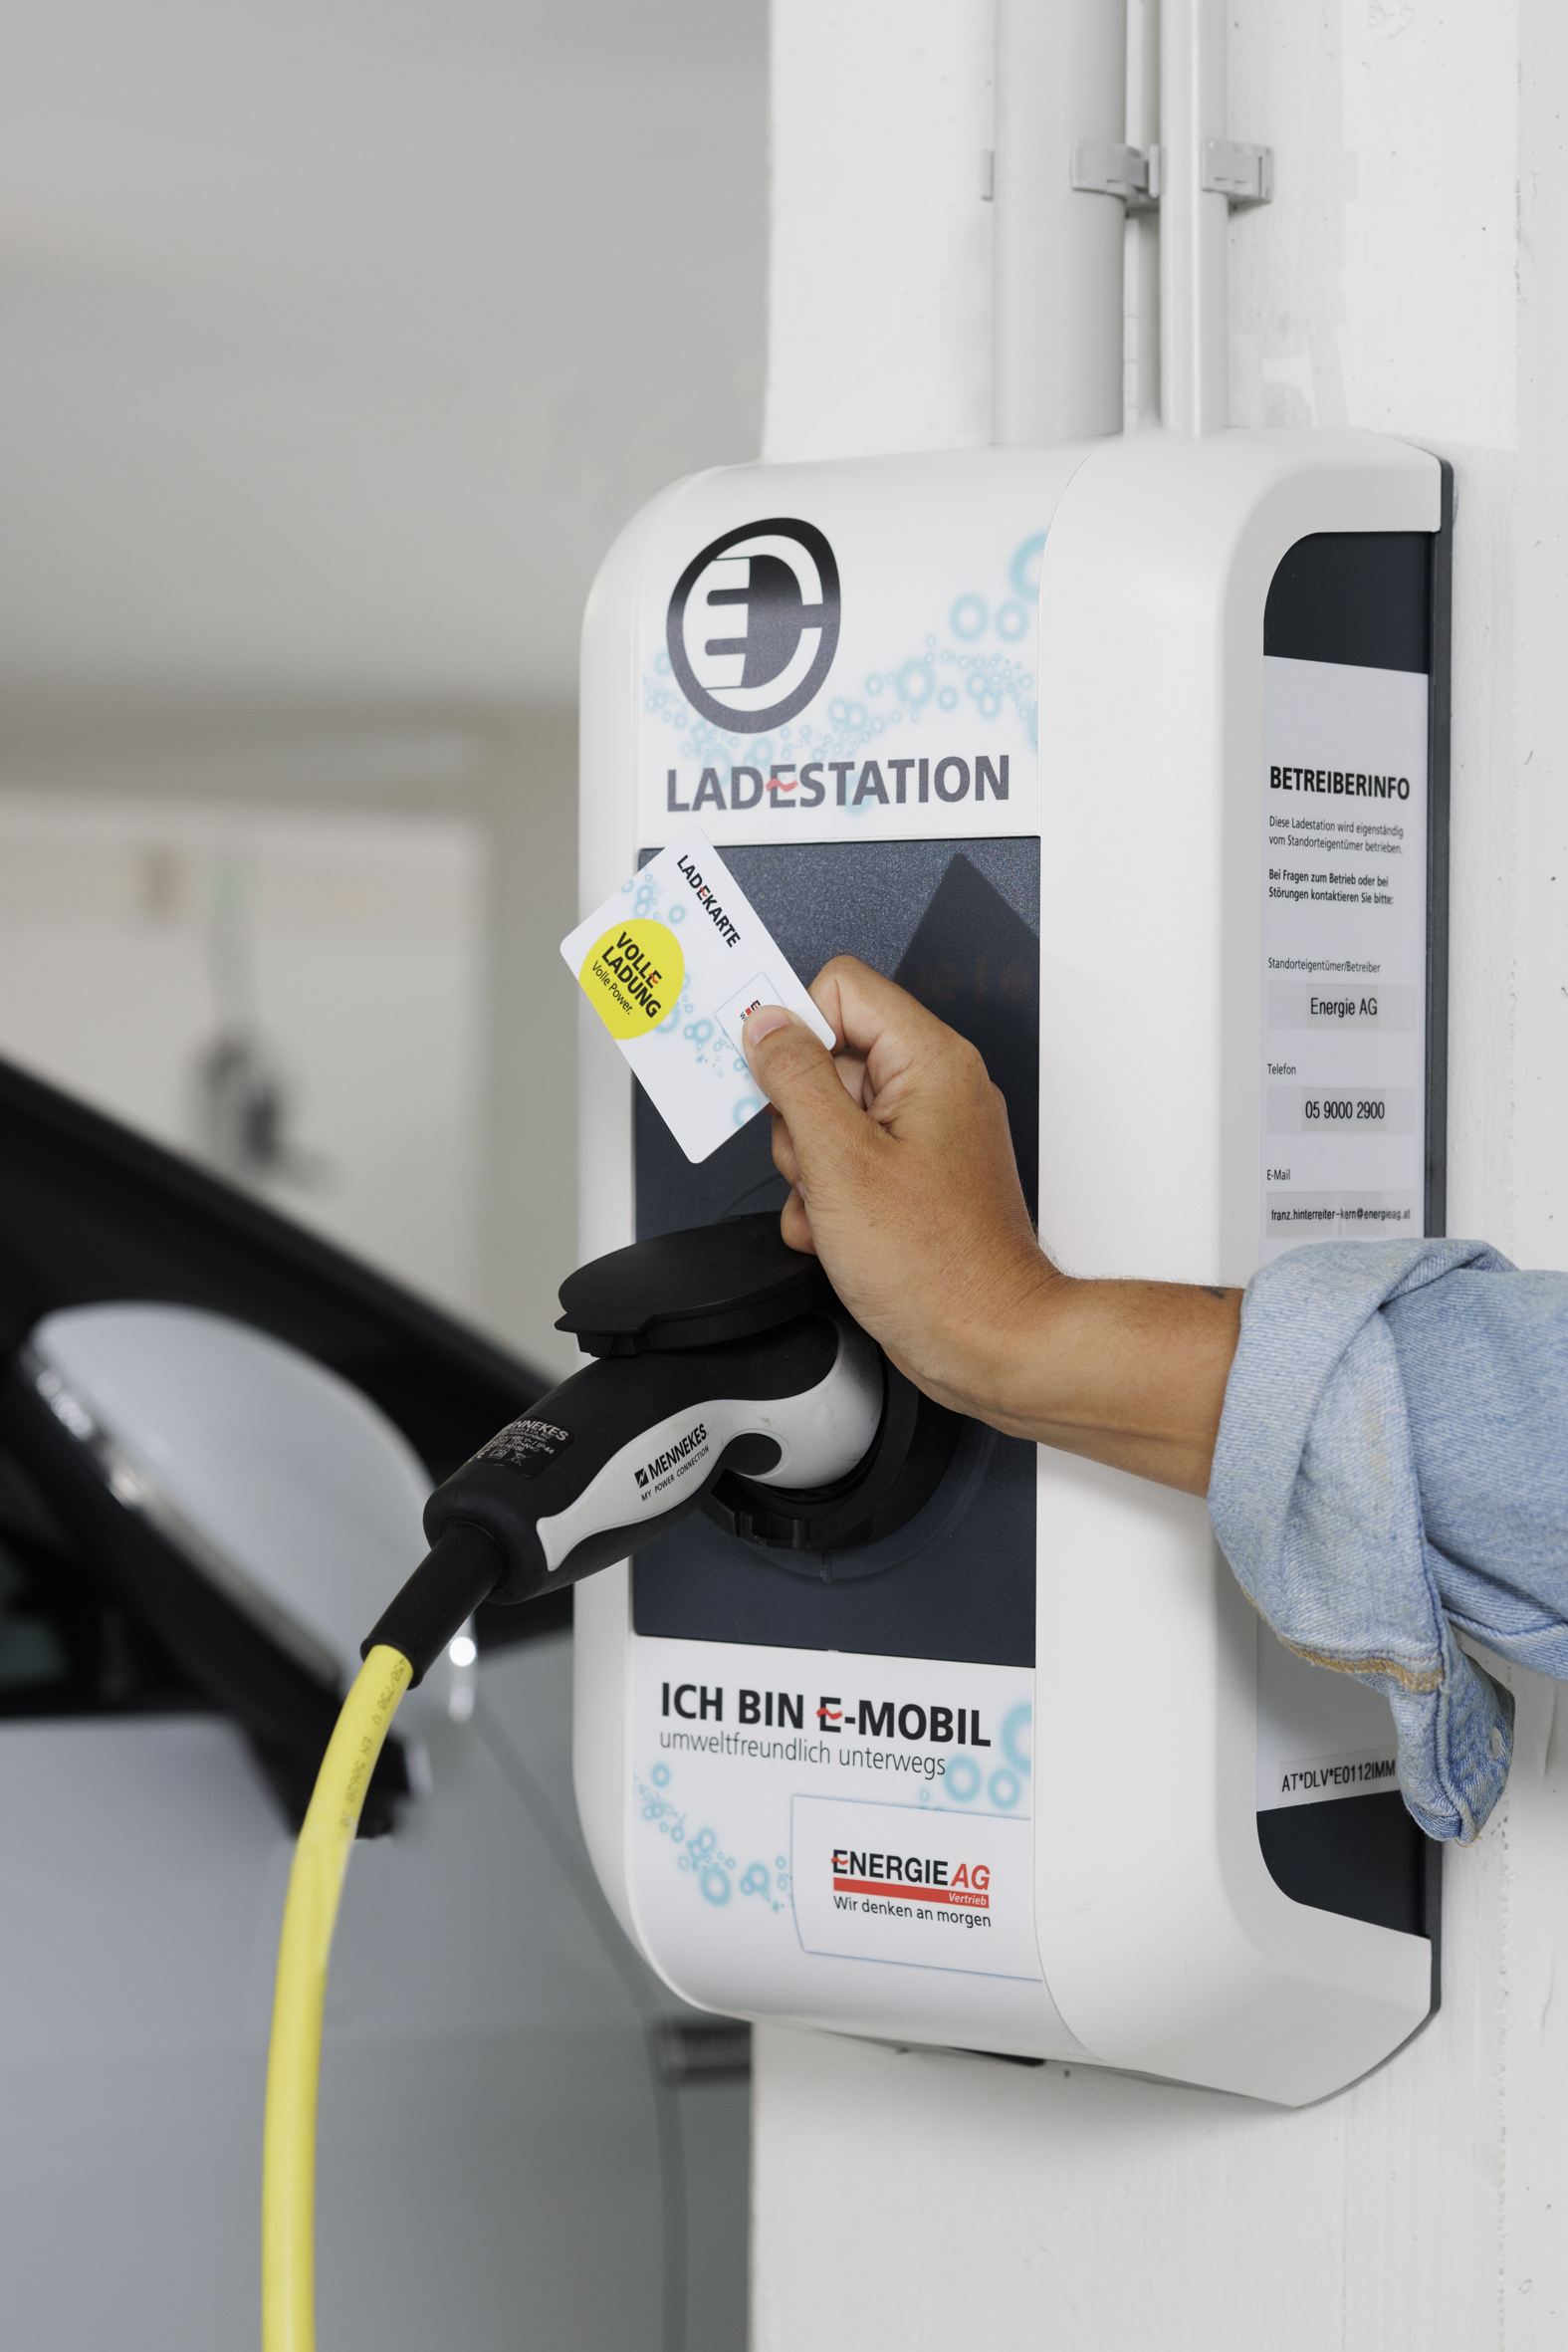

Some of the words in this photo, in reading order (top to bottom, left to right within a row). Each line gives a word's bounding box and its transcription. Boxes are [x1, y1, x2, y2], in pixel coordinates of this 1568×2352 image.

[667, 755, 1009, 813] LADESTATION
[1270, 766, 1411, 801] BETREIBERINFO
[1268, 835, 1286, 845] vom
[1287, 834, 1363, 852] Standorteigentümer
[1365, 840, 1404, 854] betrieben.
[1269, 816, 1290, 828] Diese
[1291, 818, 1336, 831] Ladestation
[1337, 822, 1354, 833] wird
[1356, 823, 1404, 839] eigenständig
[1268, 868, 1281, 880] Bei
[1283, 869, 1309, 884] Fragen
[1311, 872, 1328, 883] zum
[1329, 872, 1356, 885] Betrieb
[1358, 874, 1375, 886] oder
[1377, 875, 1389, 887] bei
[676, 854, 741, 948] LADEKARTE
[1268, 886, 1309, 901] Störungen
[1311, 888, 1359, 903] kontaktieren
[1361, 891, 1372, 904] Sie
[1374, 892, 1394, 905] bitte:
[616, 931, 662, 989] VOLLE
[1267, 957, 1381, 974] Standorteigentümer/Betreiber
[592, 960, 610, 986] Volle
[608, 982, 633, 1015] Power.
[601, 945, 662, 1019] LADUNG
[1310, 997, 1355, 1018] Energie
[1359, 998, 1378, 1016] AG
[1267, 1062, 1296, 1075] Telefon
[1305, 1101, 1320, 1119] 05
[1323, 1101, 1353, 1119] 9000
[1357, 1101, 1385, 1119] 2900
[1266, 1169, 1290, 1181] E-Mail
[648, 1423, 707, 1480] MENNEKES
[641, 1489, 652, 1502] MY
[654, 1474, 675, 1493] POWER
[677, 1445, 710, 1477] CONNECTION
[661, 1682, 724, 1723] ICH
[739, 1689, 804, 1730] BIN
[816, 1696, 992, 1748] E-MOBIL
[659, 1730, 831, 1764] umweltfreundlich
[839, 1748, 947, 1780] unterwegs
[831, 1849, 949, 1886] ENERGIE
[950, 1863, 991, 1891] AG
[833, 1895, 858, 1911] Wir
[861, 1899, 913, 1918] denken
[917, 1909, 934, 1921] an
[937, 1911, 992, 1929] morgen
[949, 1892, 987, 1906] Vertrieb
